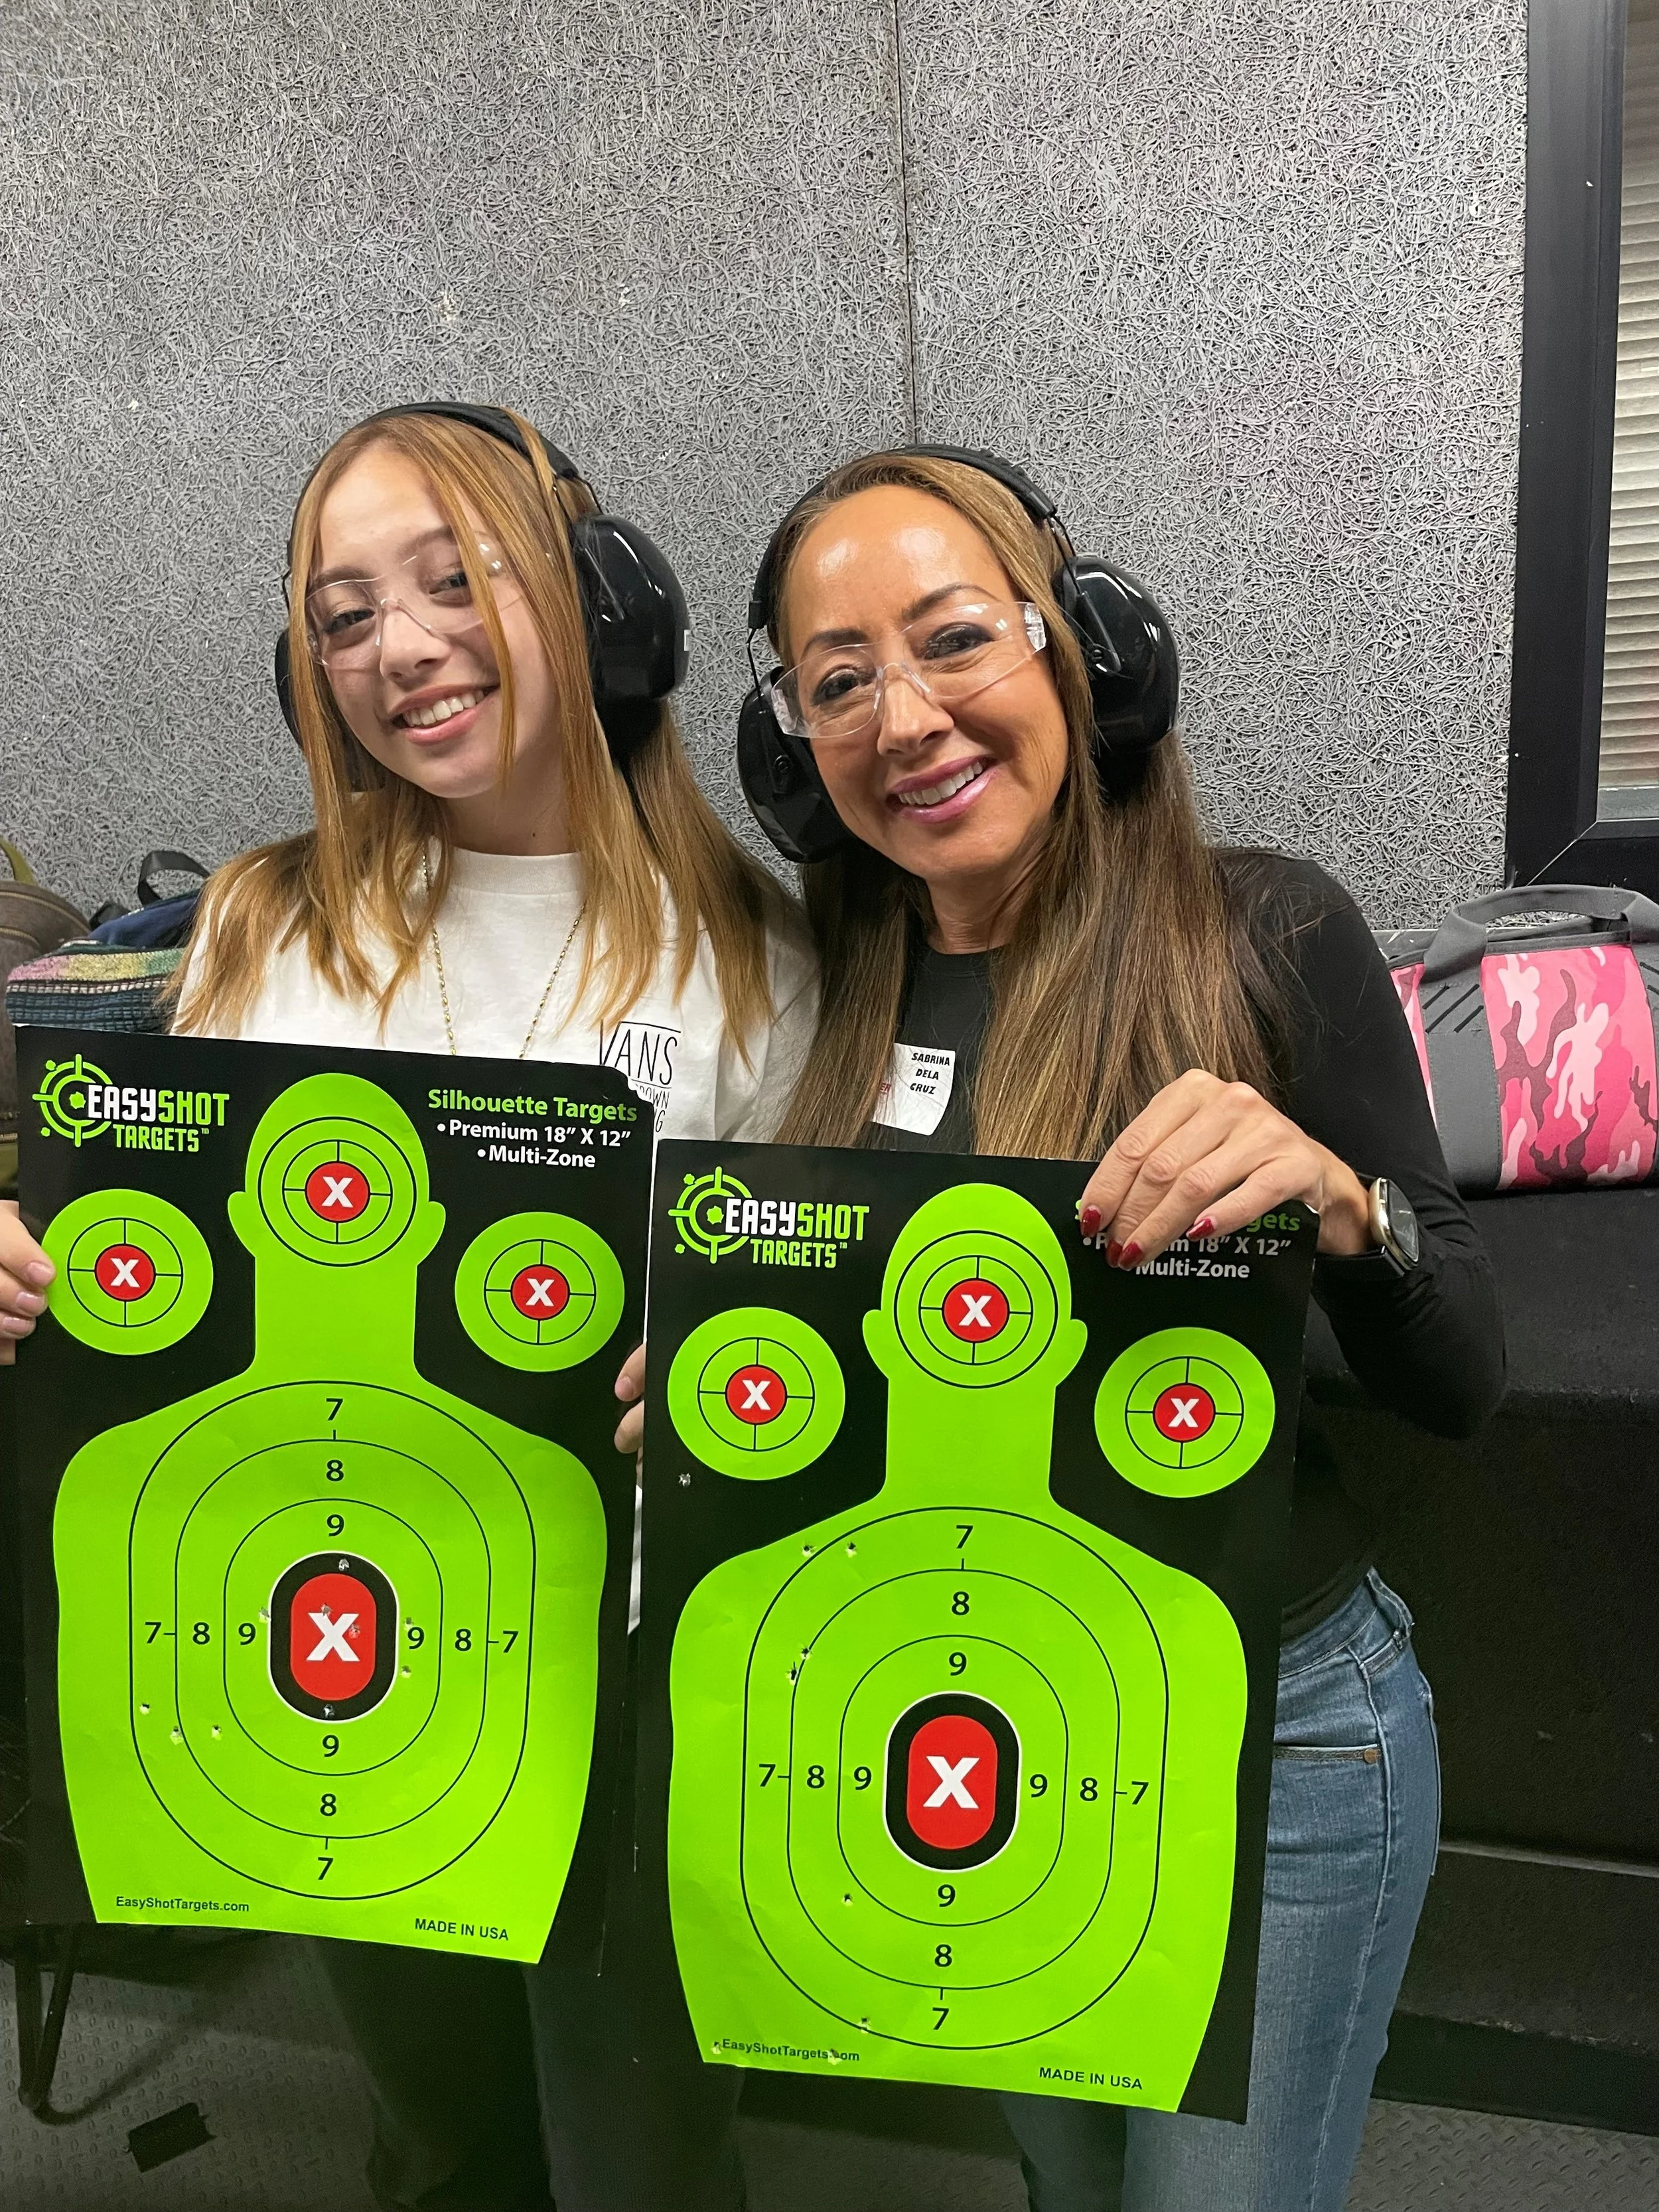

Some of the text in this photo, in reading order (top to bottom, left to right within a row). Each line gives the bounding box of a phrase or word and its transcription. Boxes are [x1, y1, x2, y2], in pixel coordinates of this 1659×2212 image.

[599, 1020, 680, 1085] VANS
[911, 1053, 950, 1066] SABRINA
[916, 1068, 939, 1080] DELA
[910, 1082, 936, 1094] CRUZ
[88, 1084, 230, 1126] EASYSHOT
[428, 1089, 548, 1116] Silhouette
[553, 1096, 638, 1124] Targets
[449, 1119, 538, 1142] Premium
[580, 1128, 595, 1145] X
[488, 1145, 596, 1168] Multi-Zone
[321, 1176, 353, 1208] X
[725, 1198, 870, 1241] EASYSHOT
[1234, 1236, 1250, 1254] X
[110, 1258, 140, 1288] X
[526, 1278, 555, 1307] X
[958, 1294, 992, 1327] X
[741, 1379, 771, 1410] X
[326, 1398, 343, 1421] 7
[1168, 1398, 1199, 1428] X
[326, 1459, 344, 1482] 8
[326, 1514, 344, 1536] 9
[956, 1524, 974, 1549] 7
[951, 1591, 970, 1615] 8
[145, 1612, 519, 1662] 7 8 9 X 9 8 7
[949, 1652, 967, 1676] 9
[322, 1735, 339, 1757] 9
[758, 1755, 1149, 1809] 7 8 9 X 9 8 7
[320, 1793, 336, 1816] 8
[318, 1857, 333, 1880] 7
[115, 1896, 250, 1912] EasyShotTargets.com
[938, 1884, 956, 1907] 9
[415, 1918, 509, 1941] MADE IN USA
[934, 1944, 952, 1967] 8
[932, 2007, 949, 2030] 7
[1039, 2067, 1143, 2090] MADE IN USA
